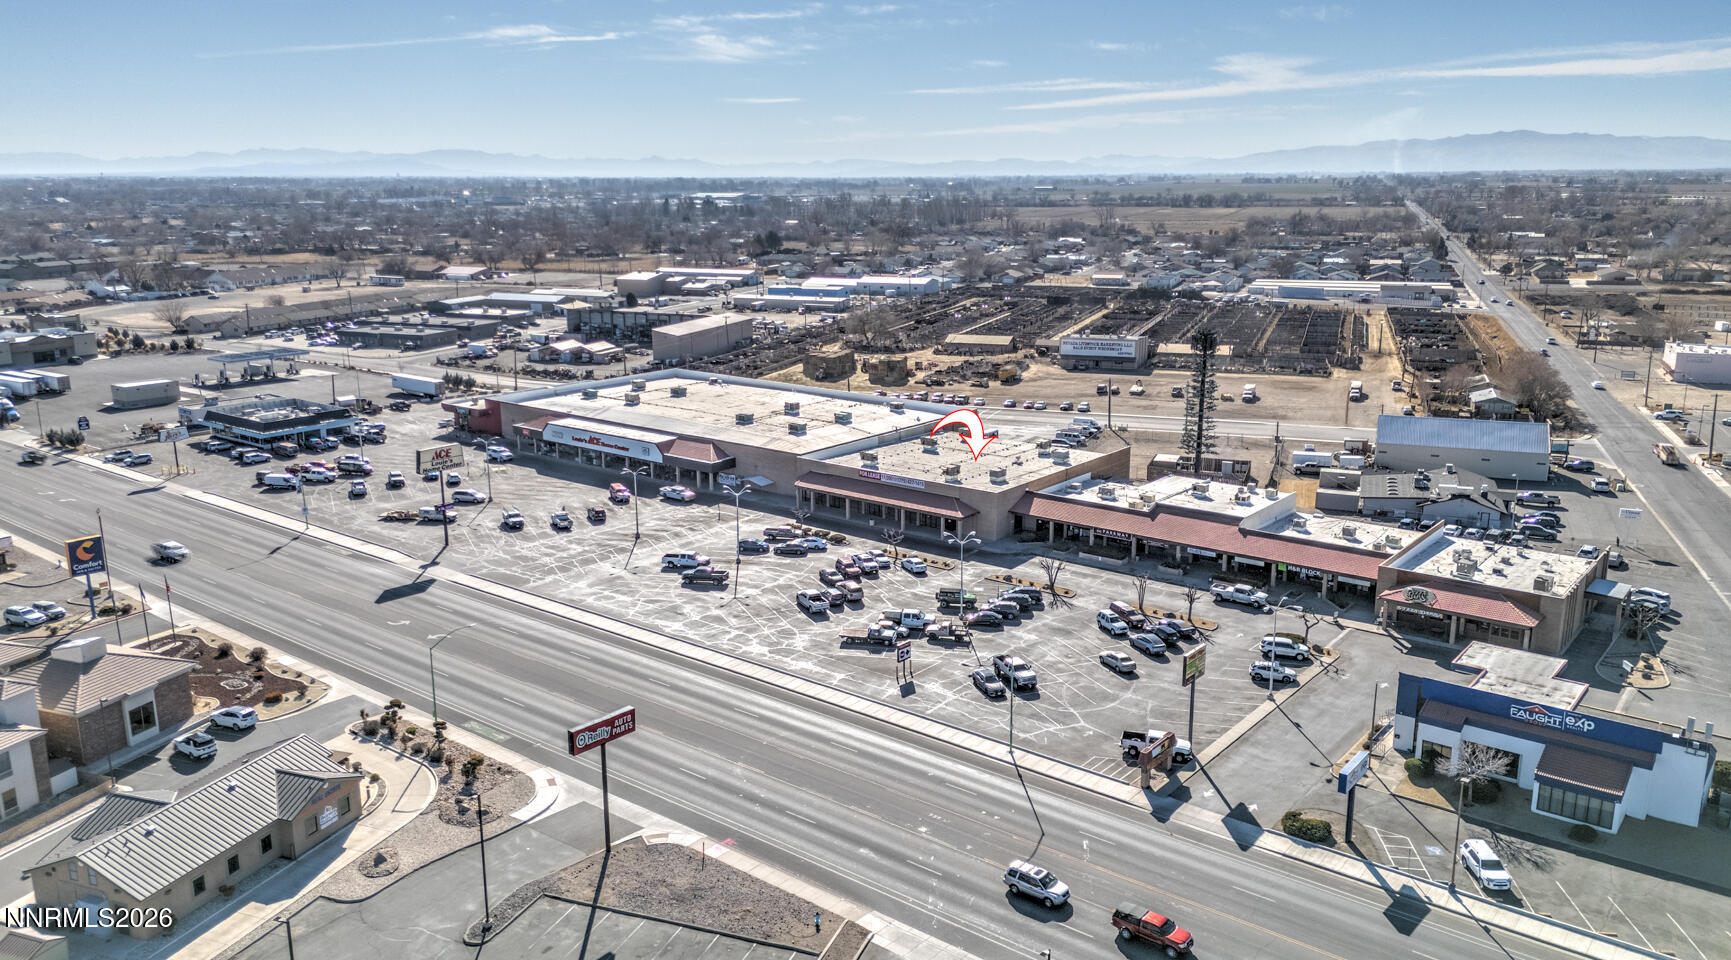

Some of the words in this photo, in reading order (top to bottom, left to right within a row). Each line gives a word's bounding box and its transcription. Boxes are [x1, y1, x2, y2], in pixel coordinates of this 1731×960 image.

[432, 448, 452, 460] ACE
[431, 458, 453, 467] Louie's
[441, 462, 463, 470] Center
[1102, 529, 1129, 538] PARKWAY
[73, 560, 103, 571] Comfort
[1287, 564, 1300, 572] H&R
[1301, 567, 1320, 576] BLOCK
[614, 714, 632, 727] AUTO
[1510, 707, 1562, 726] FAUGHT
[612, 722, 633, 735] PARTS
[576, 726, 611, 748] O'Reilly
